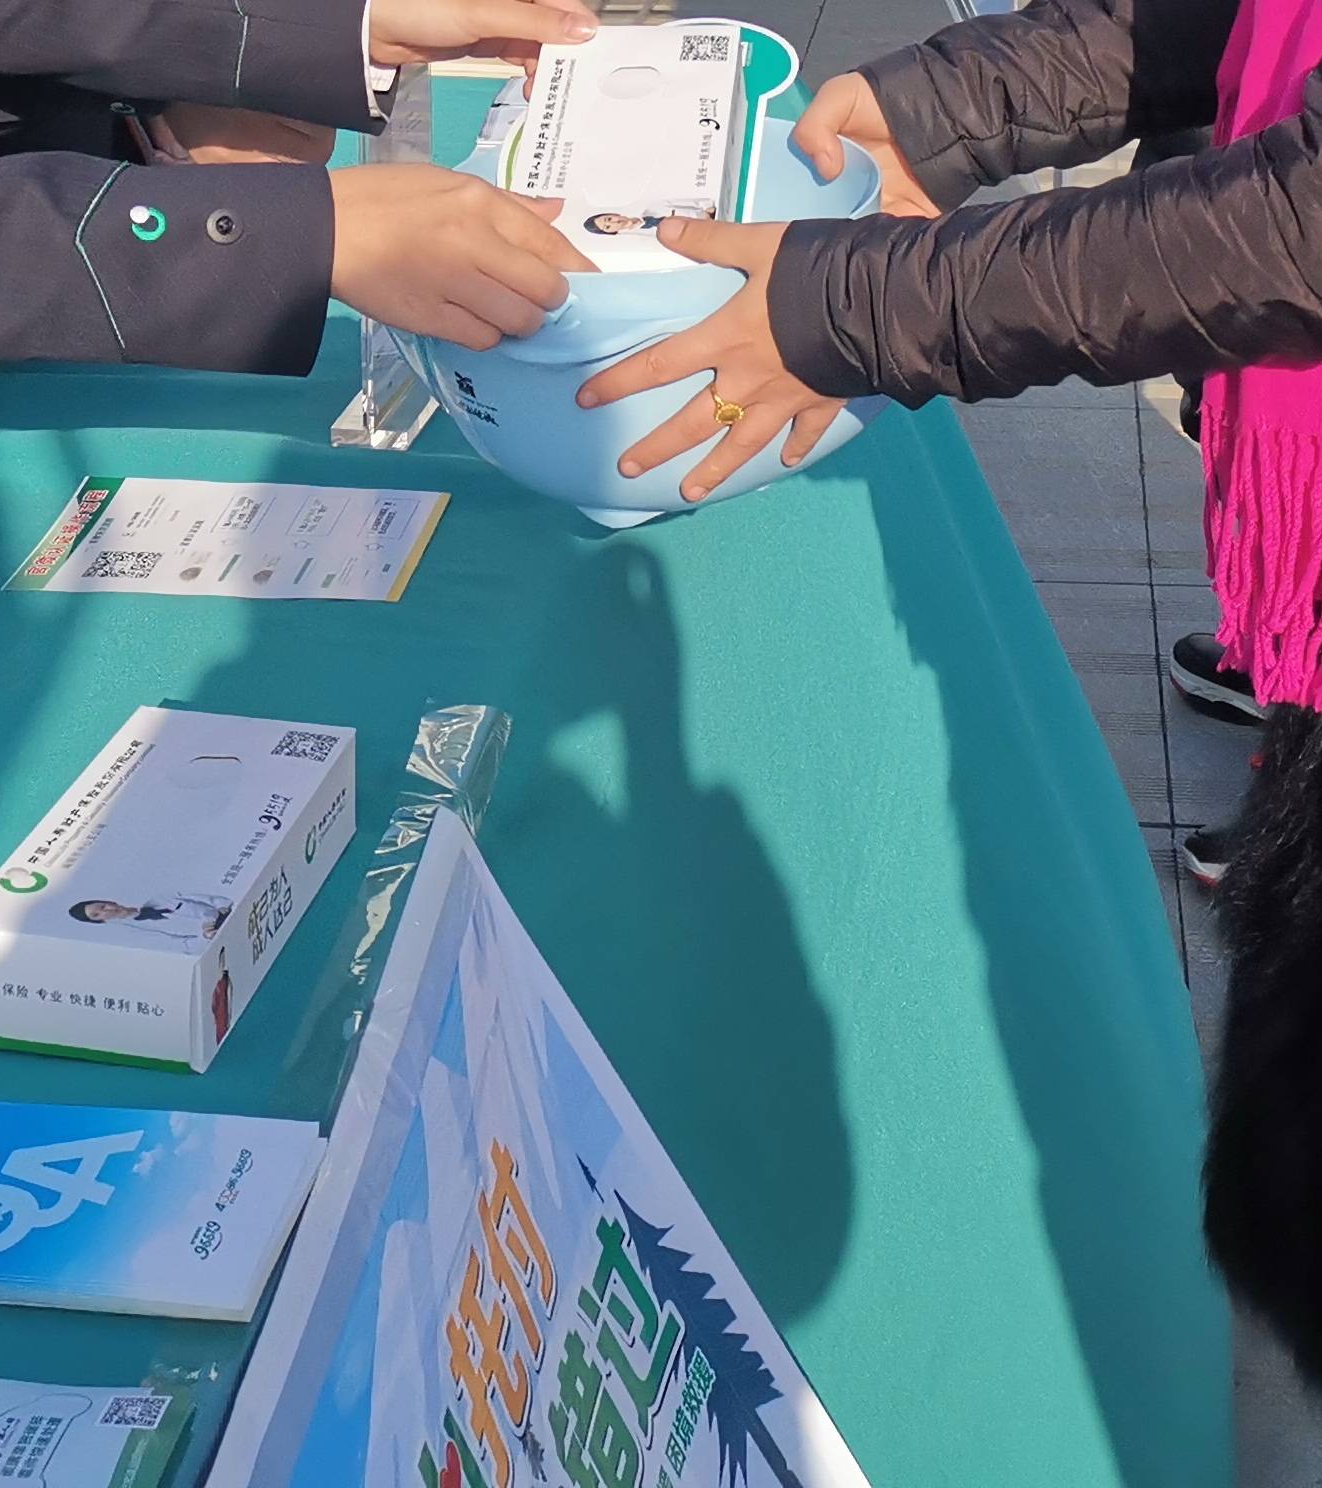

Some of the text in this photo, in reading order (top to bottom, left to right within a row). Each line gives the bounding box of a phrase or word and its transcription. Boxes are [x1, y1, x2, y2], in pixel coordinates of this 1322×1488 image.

[36, 988, 62, 1003] 专业
[70, 992, 96, 1008] 快捷
[103, 996, 130, 1013] 便利
[137, 1001, 164, 1017] 贴心
